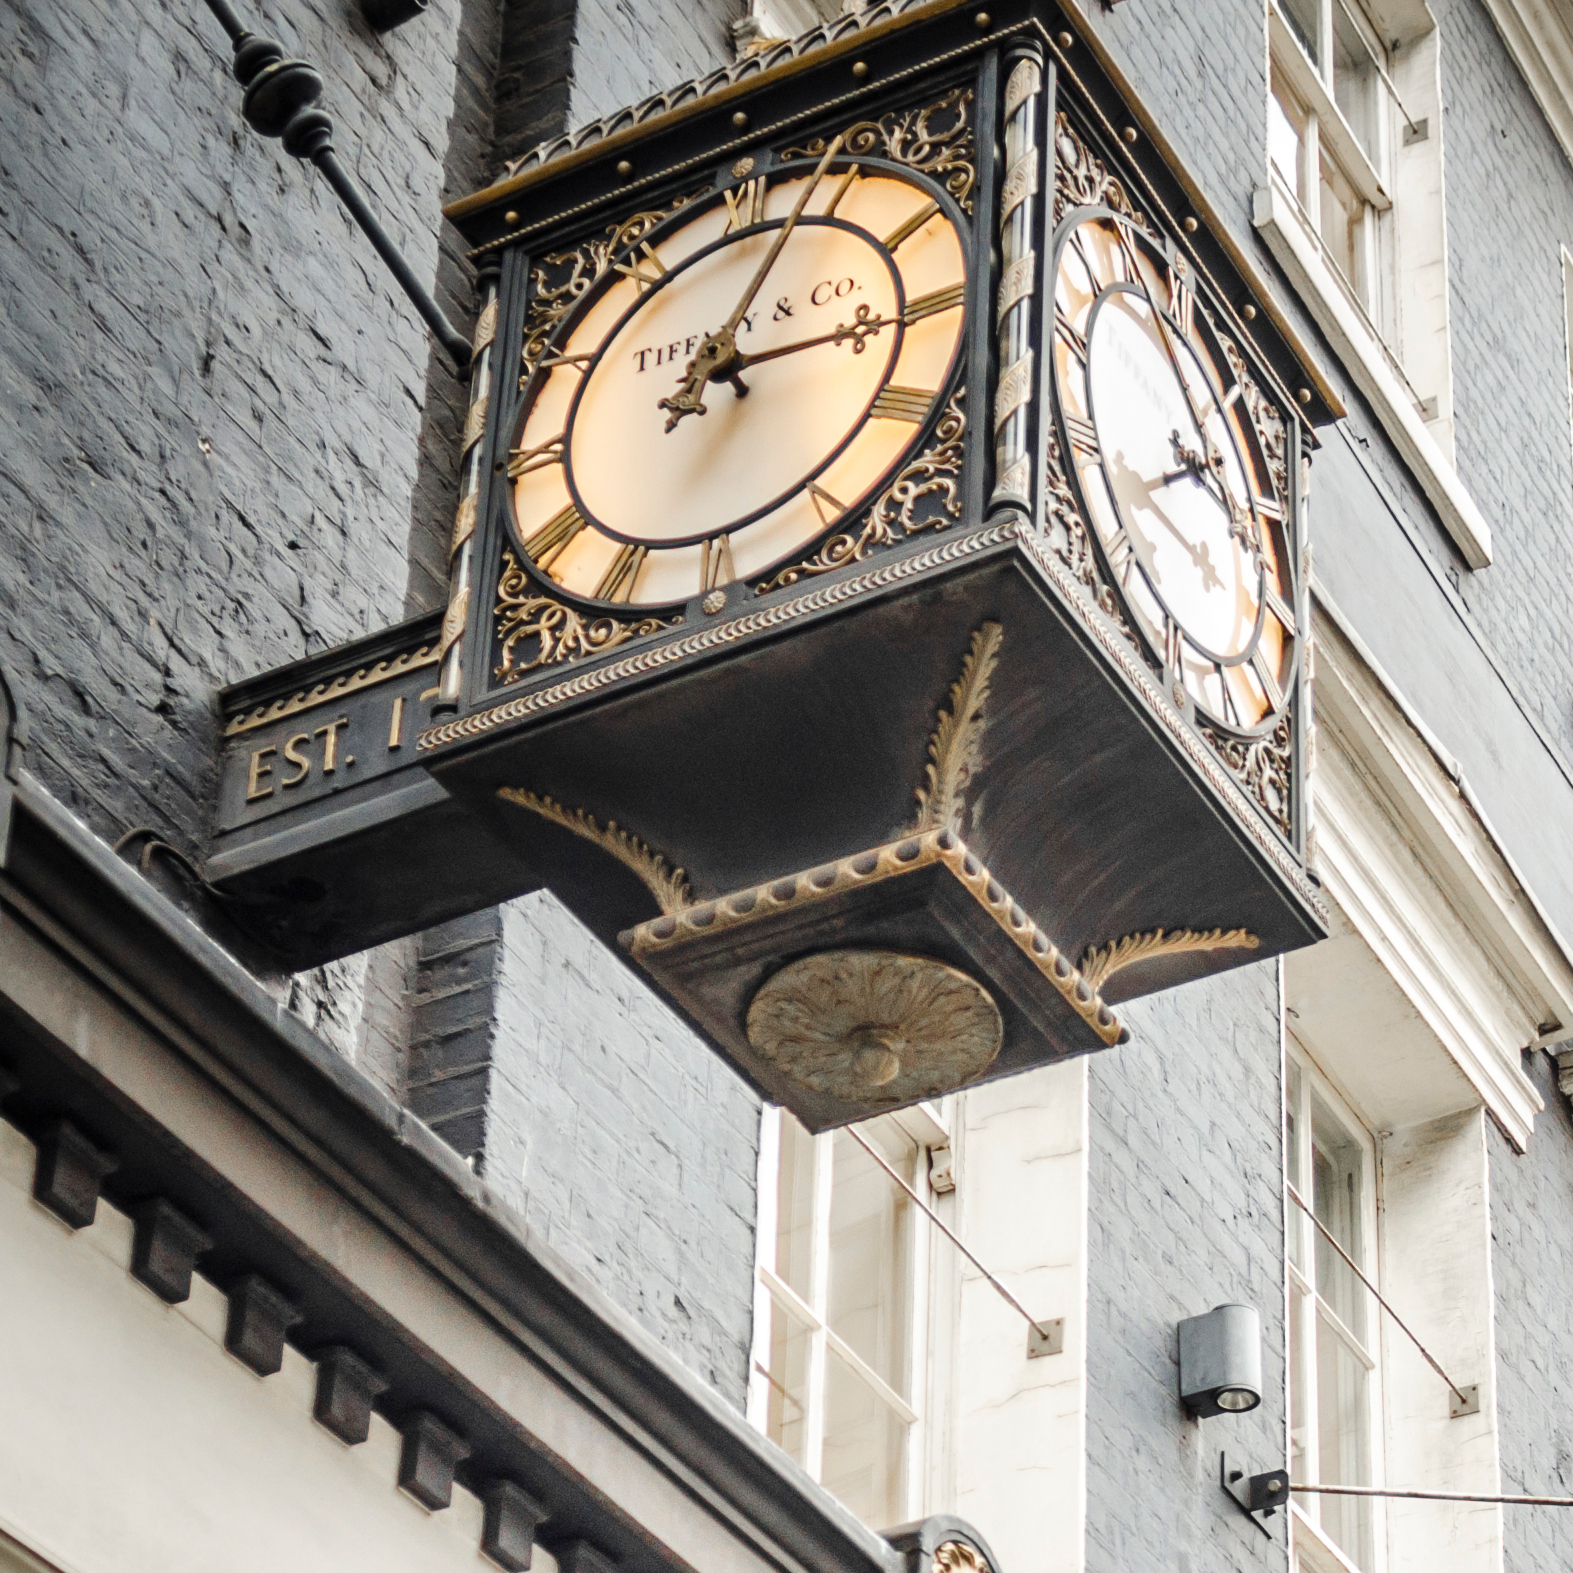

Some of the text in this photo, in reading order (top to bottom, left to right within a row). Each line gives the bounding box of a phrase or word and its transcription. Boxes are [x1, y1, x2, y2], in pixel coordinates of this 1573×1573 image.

[632, 312, 759, 374] TIFFY
[772, 296, 795, 322] &
[246, 716, 357, 804] EST.
